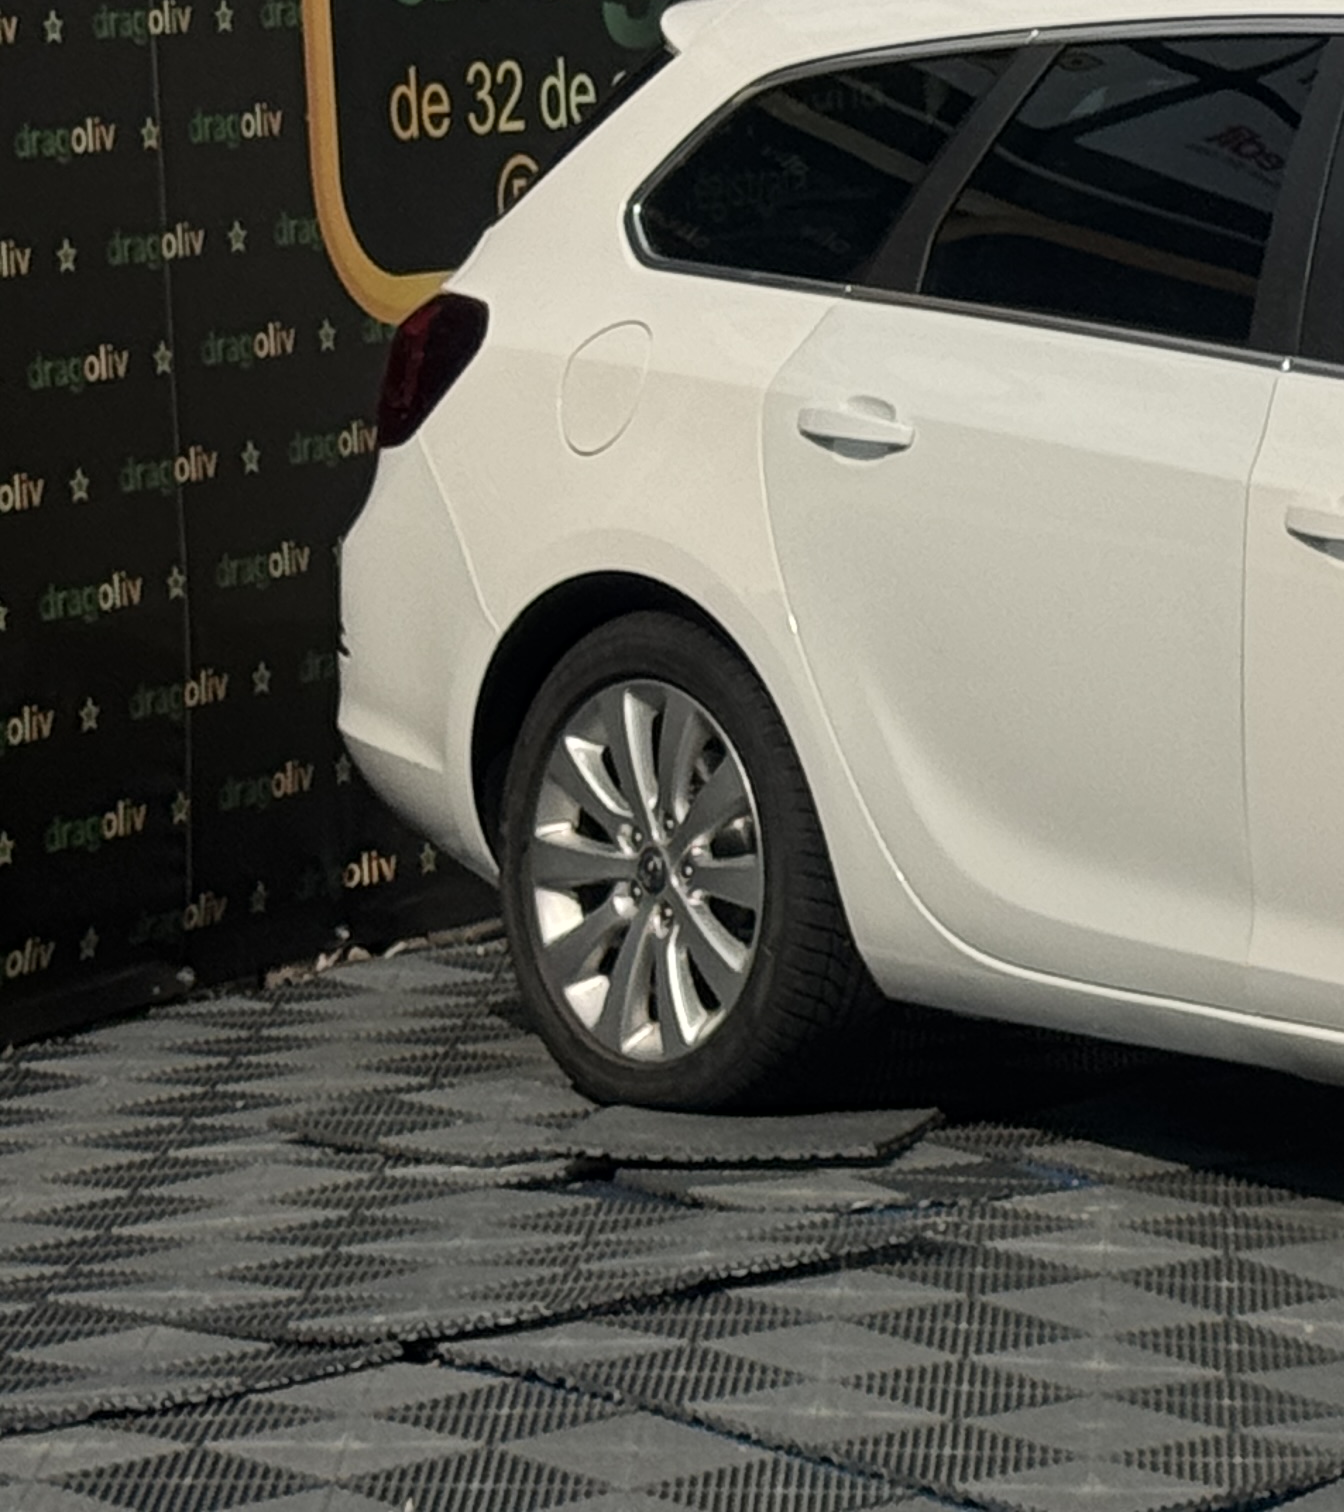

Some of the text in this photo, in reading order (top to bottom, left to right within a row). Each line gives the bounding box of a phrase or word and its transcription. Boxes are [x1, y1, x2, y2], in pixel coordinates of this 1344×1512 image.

[92, 0, 193, 45] dragoliv
[389, 55, 597, 140] de 32 de
[13, 116, 117, 163] dragoliv
[188, 102, 283, 149] dragoliv
[105, 221, 205, 270] dragoliv
[26, 343, 130, 392] dragoliv
[202, 320, 296, 368] dragoliv
[118, 444, 219, 495] dragoliv
[38, 570, 143, 623] dragoliv
